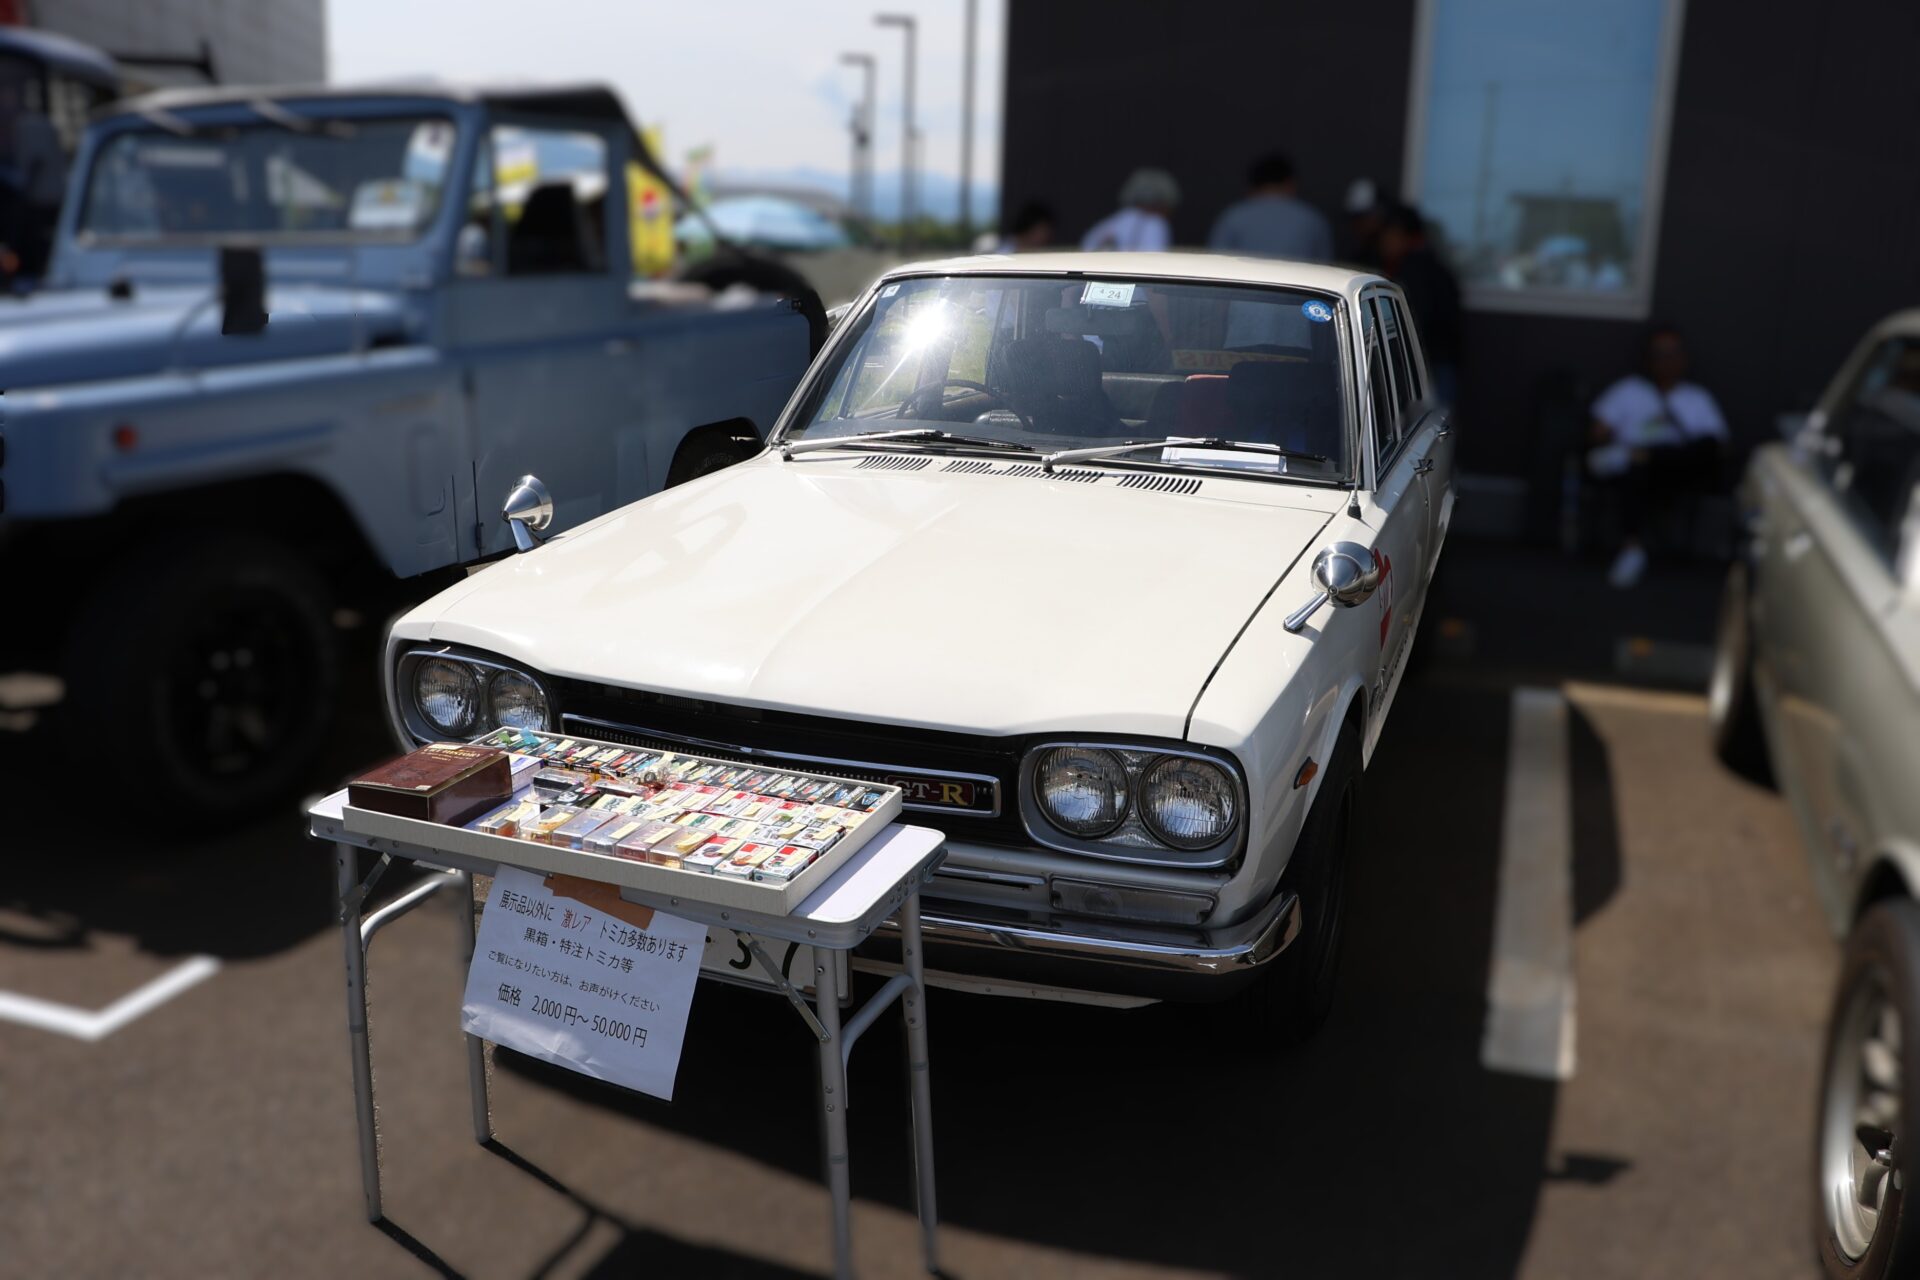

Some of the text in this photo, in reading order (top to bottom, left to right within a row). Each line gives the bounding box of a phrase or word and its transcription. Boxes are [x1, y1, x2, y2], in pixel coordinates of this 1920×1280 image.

[892, 780, 969, 806] GT-R
[500, 889, 689, 963] 展示品以外に 激レア トミカ多数あります
[498, 981, 522, 1008] 価格
